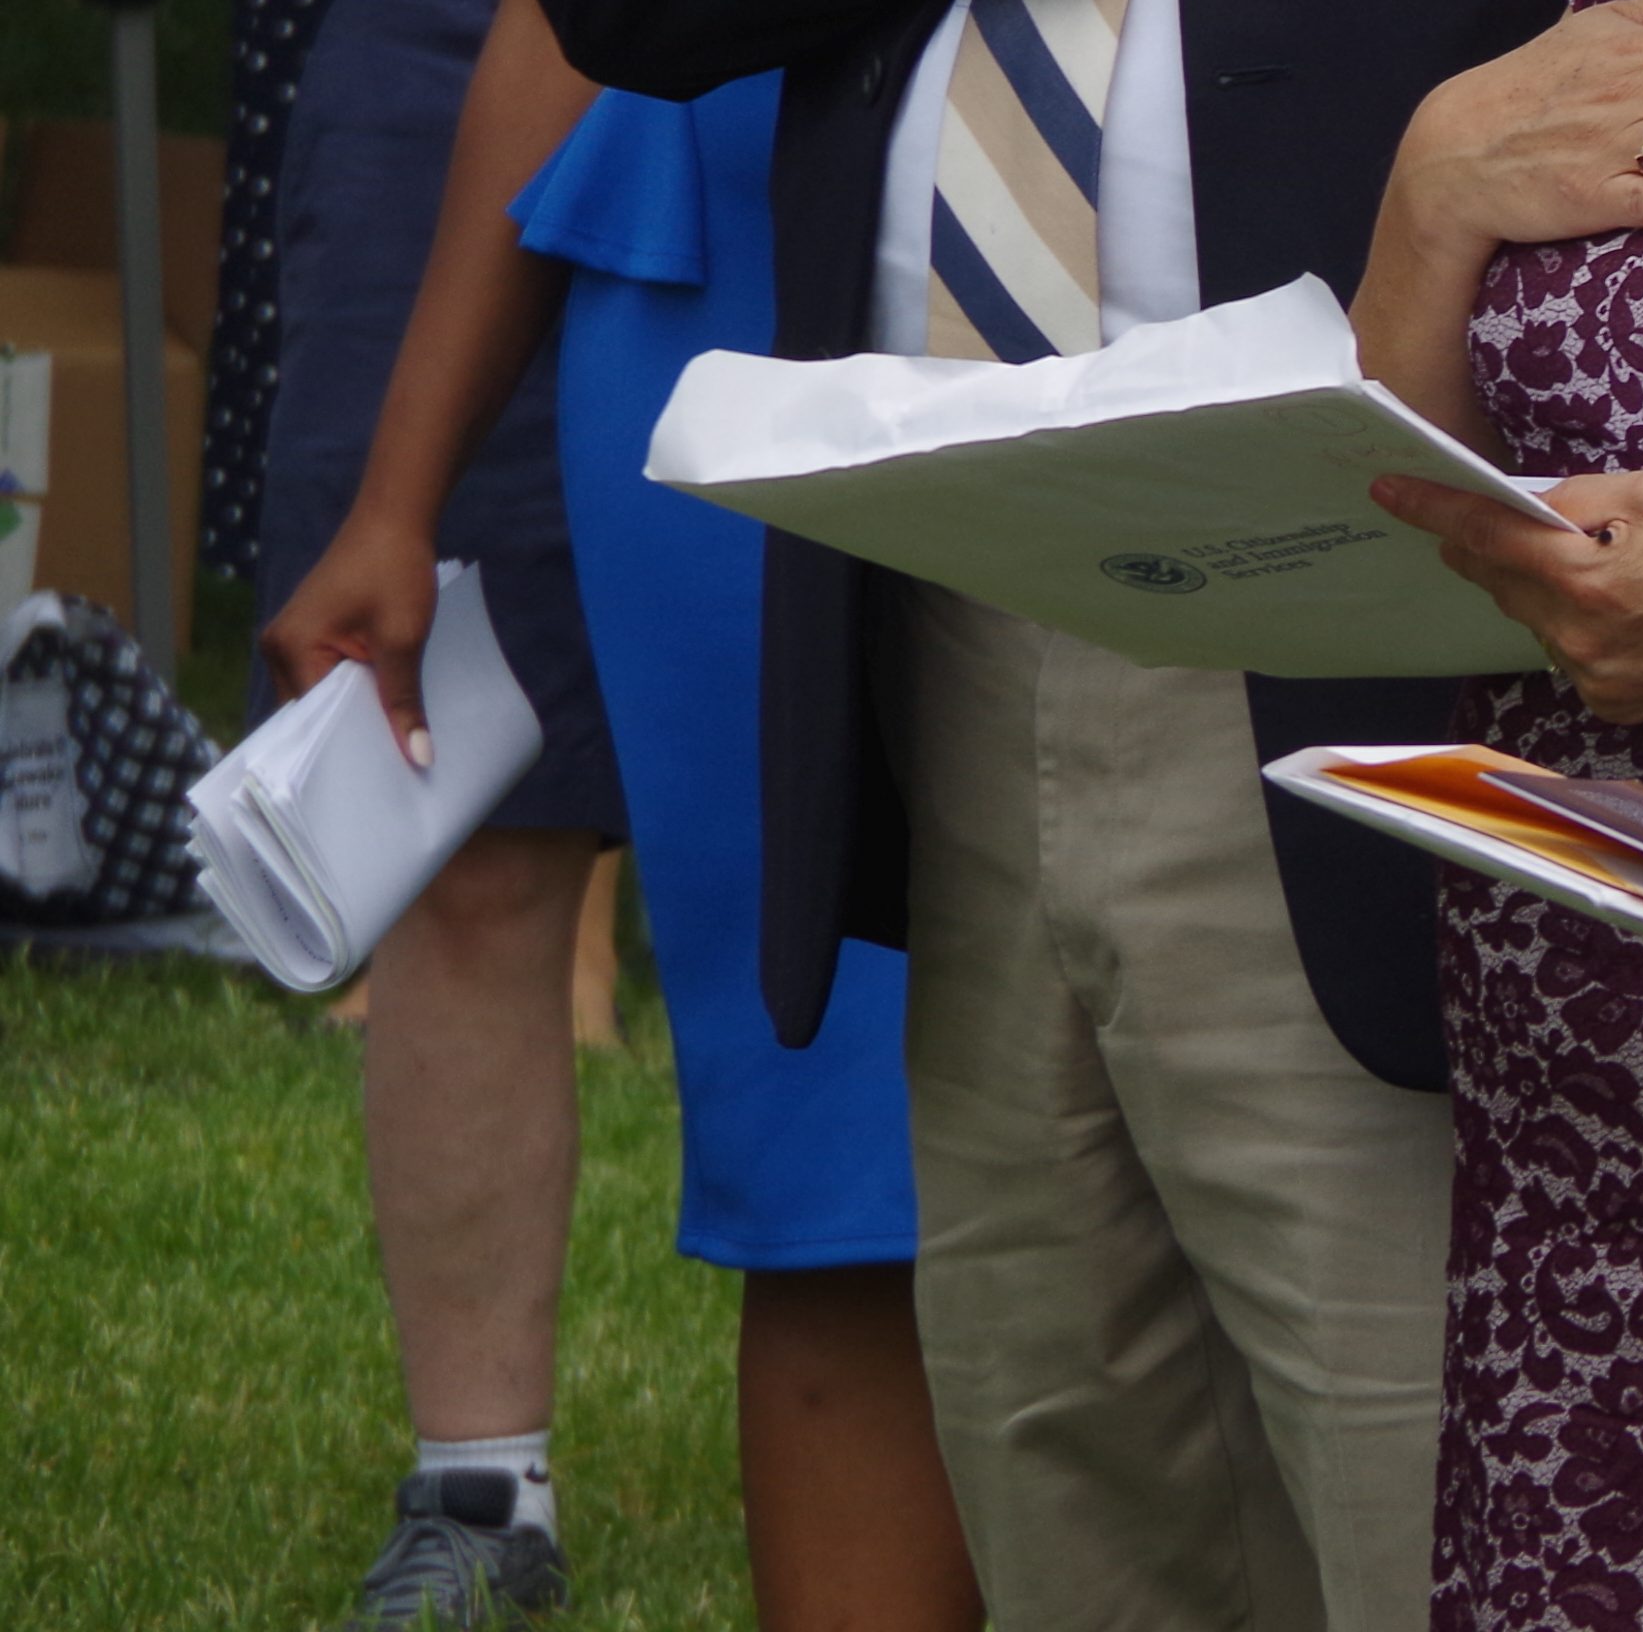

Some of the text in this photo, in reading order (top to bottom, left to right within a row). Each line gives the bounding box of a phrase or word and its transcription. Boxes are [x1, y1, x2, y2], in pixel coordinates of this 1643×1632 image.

[1206, 527, 1388, 570] and Immigration
[1226, 523, 1350, 553] Citizenship
[1222, 558, 1313, 581] Services
